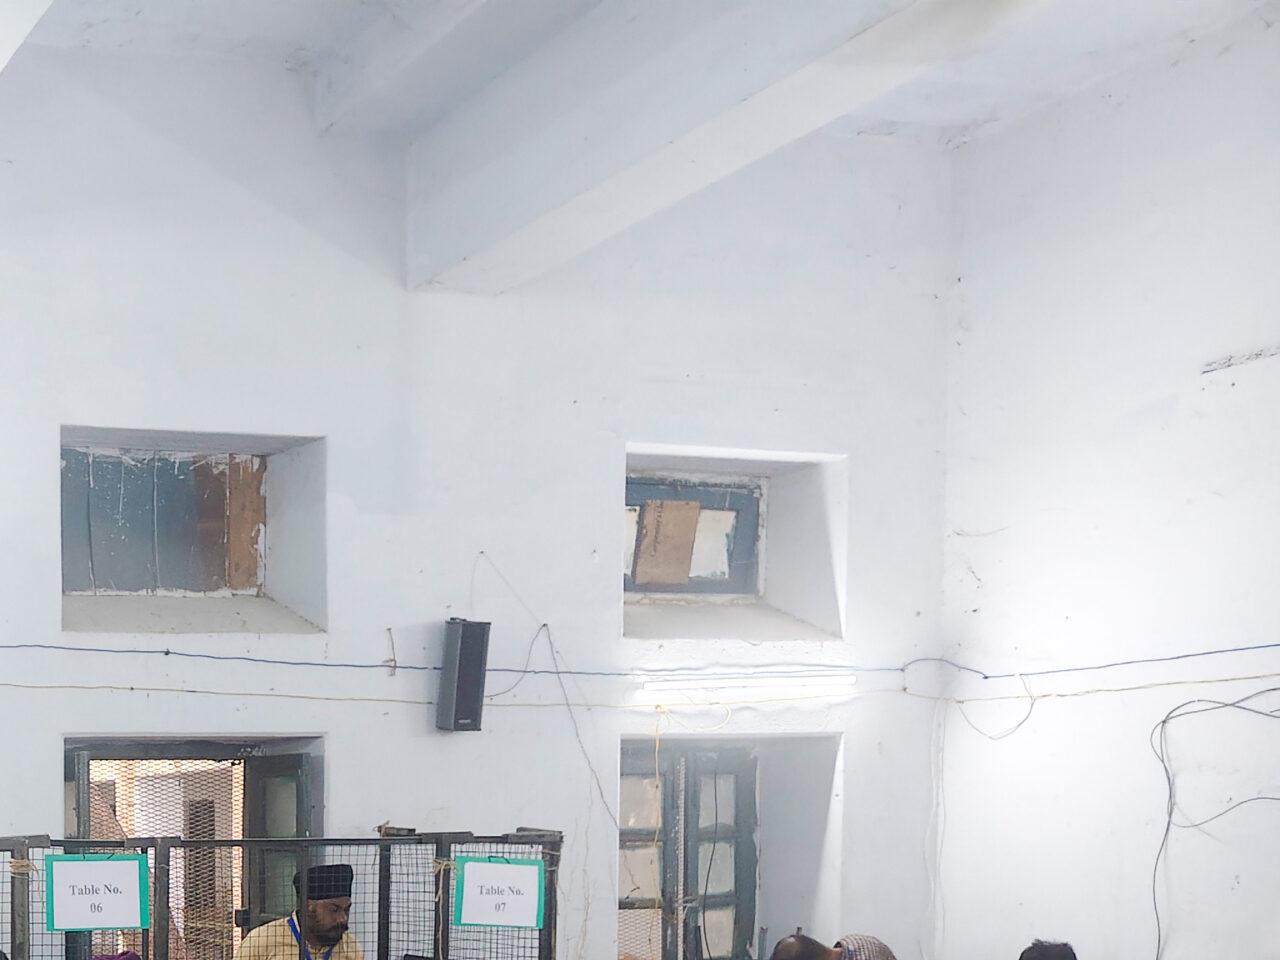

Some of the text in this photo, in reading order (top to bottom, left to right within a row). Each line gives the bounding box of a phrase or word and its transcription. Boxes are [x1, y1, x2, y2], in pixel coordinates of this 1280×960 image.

[68, 884, 122, 896] Table No.
[477, 885, 524, 896] Table No.
[90, 902, 103, 913] 06
[494, 902, 506, 912] 07
